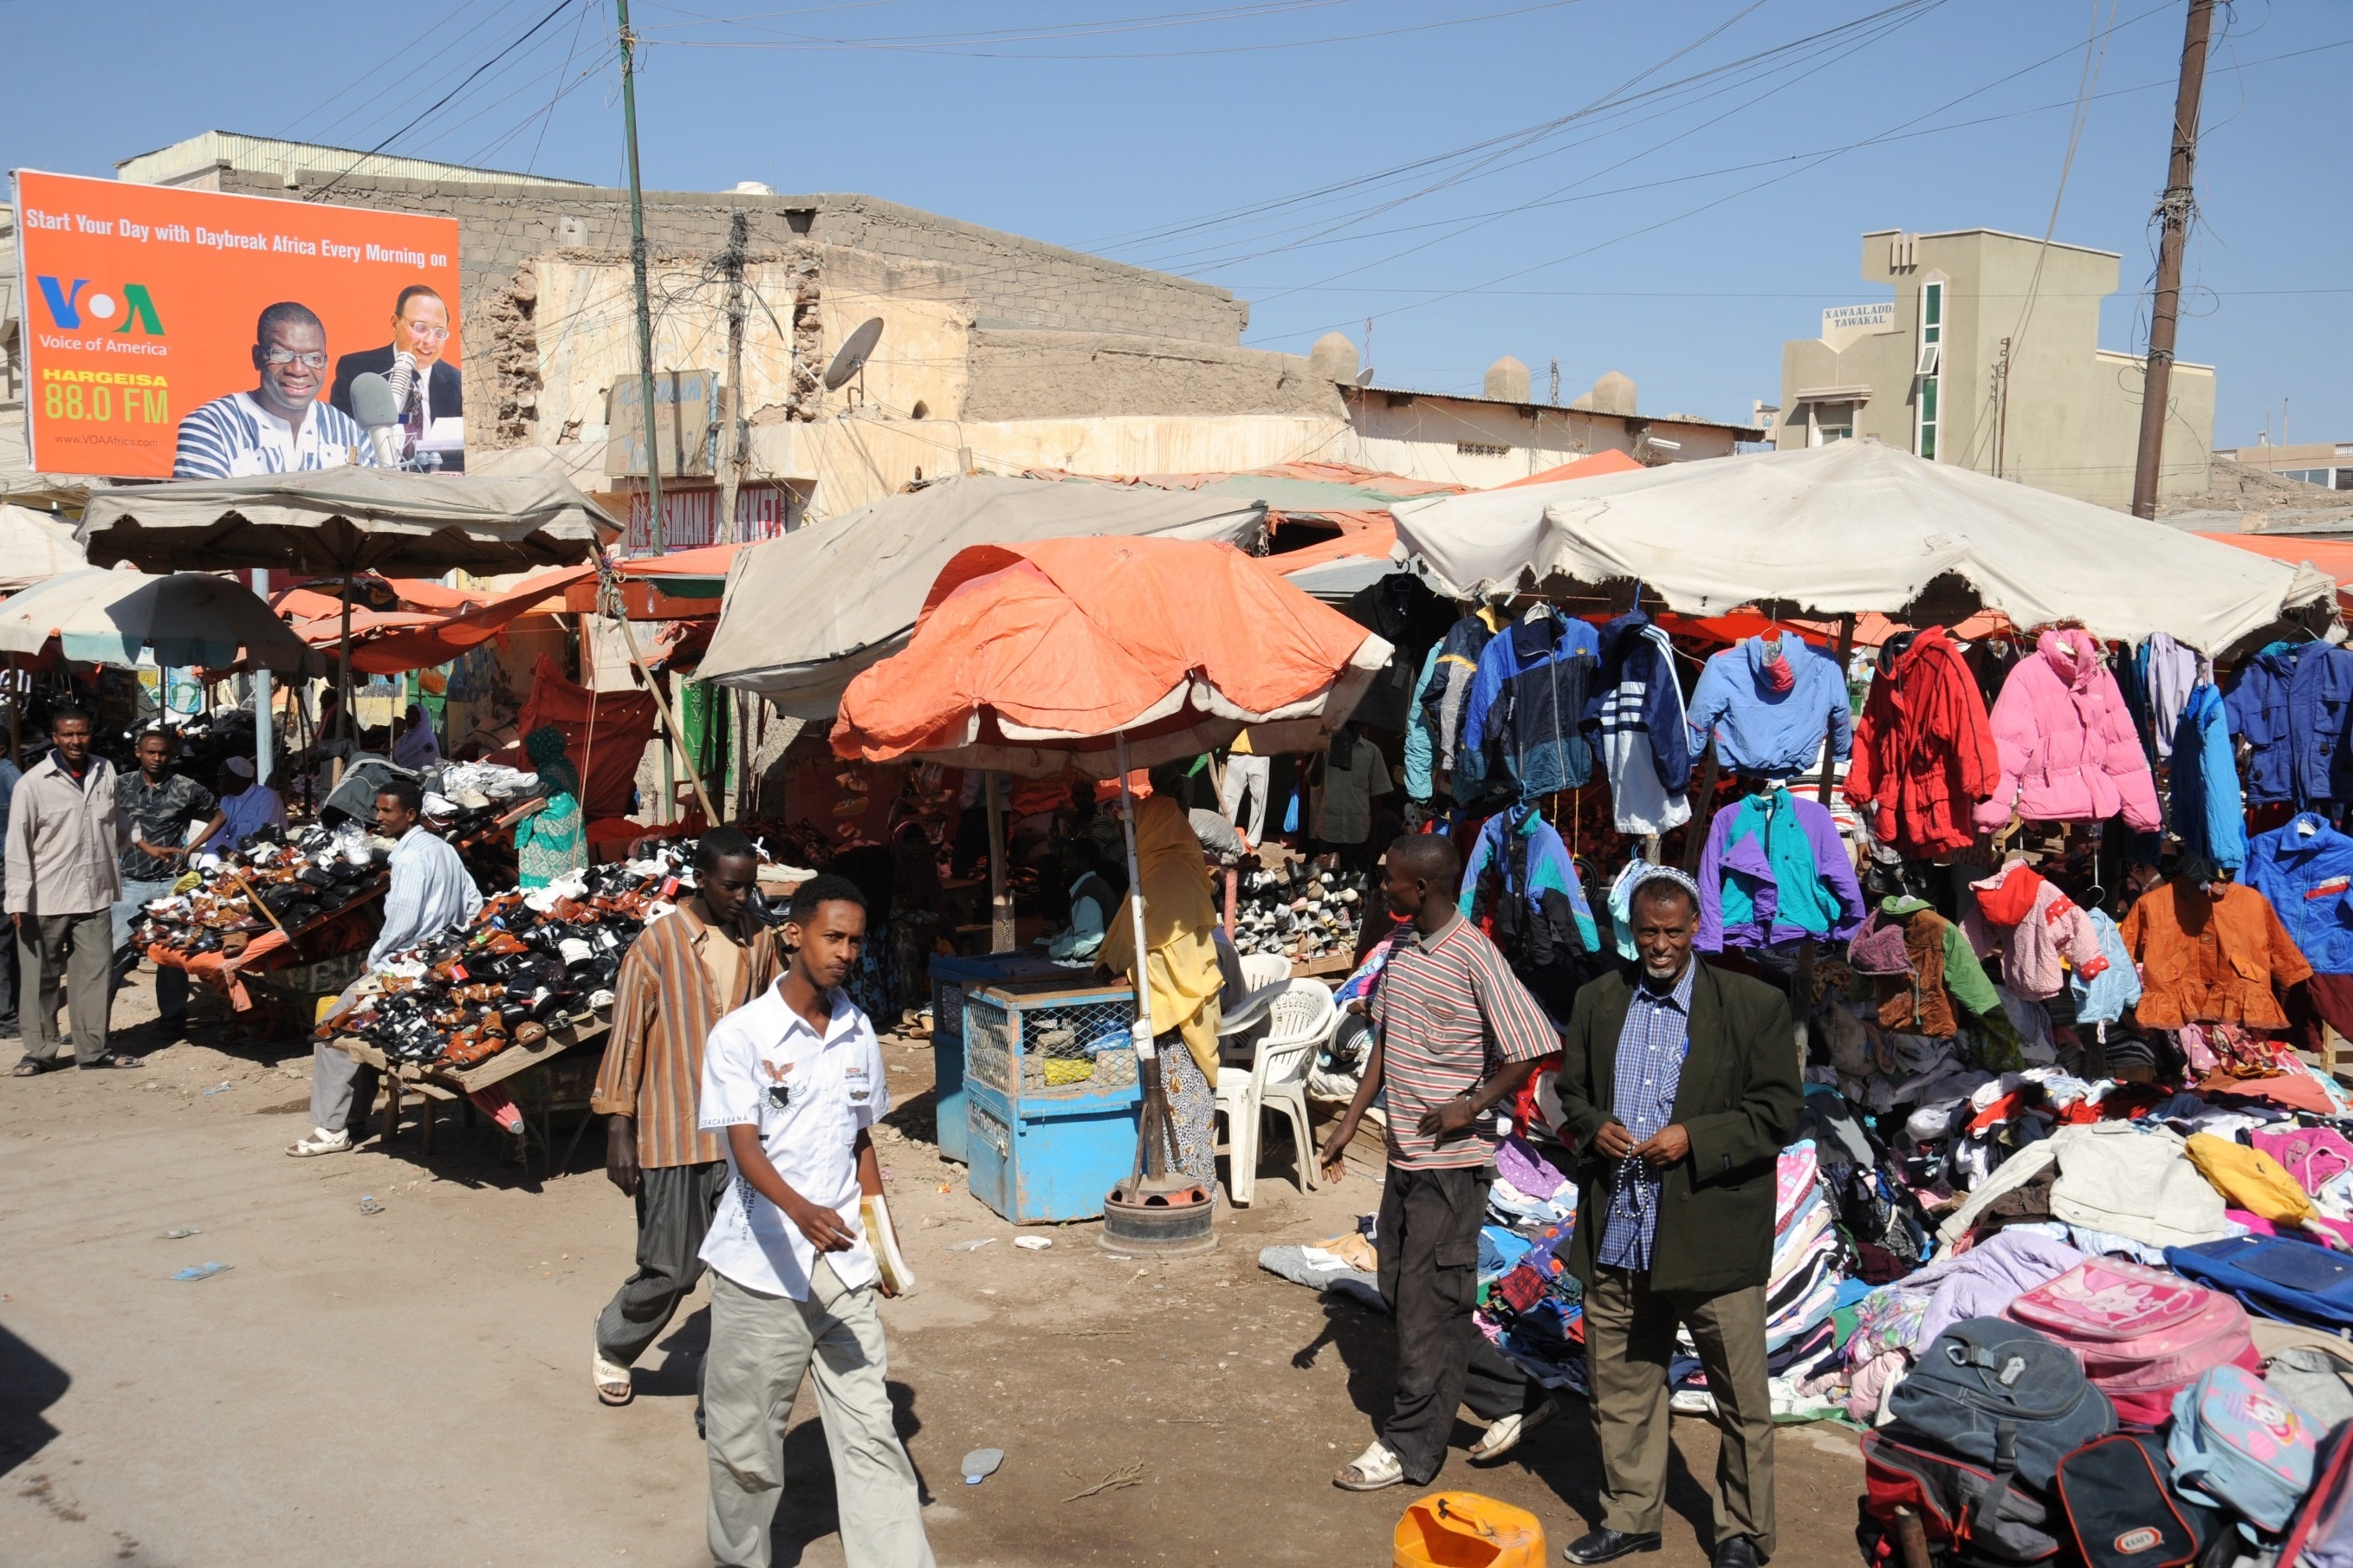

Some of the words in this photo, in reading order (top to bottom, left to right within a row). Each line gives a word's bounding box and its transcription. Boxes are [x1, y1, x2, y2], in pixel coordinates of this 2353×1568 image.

[26, 209, 71, 231] Start
[75, 214, 113, 236] Your
[120, 218, 150, 243] Day
[155, 224, 190, 243] with
[196, 226, 268, 251] Daybreak
[273, 235, 316, 256] Africa
[321, 239, 360, 263] Every
[366, 244, 425, 269] Morning
[430, 253, 447, 268] on
[36, 275, 165, 336] VOA
[1834, 315, 1886, 328] TAWAKAL
[39, 334, 81, 350] Voice
[86, 338, 103, 351] of
[106, 340, 167, 356] America
[43, 368, 168, 387] HARGEISA
[45, 383, 111, 422] 88.0
[124, 388, 169, 424] FM
[55, 435, 159, 447] www.VOAAfrica.com
[652, 491, 709, 547] SMANI
[713, 489, 779, 543] MRKET
